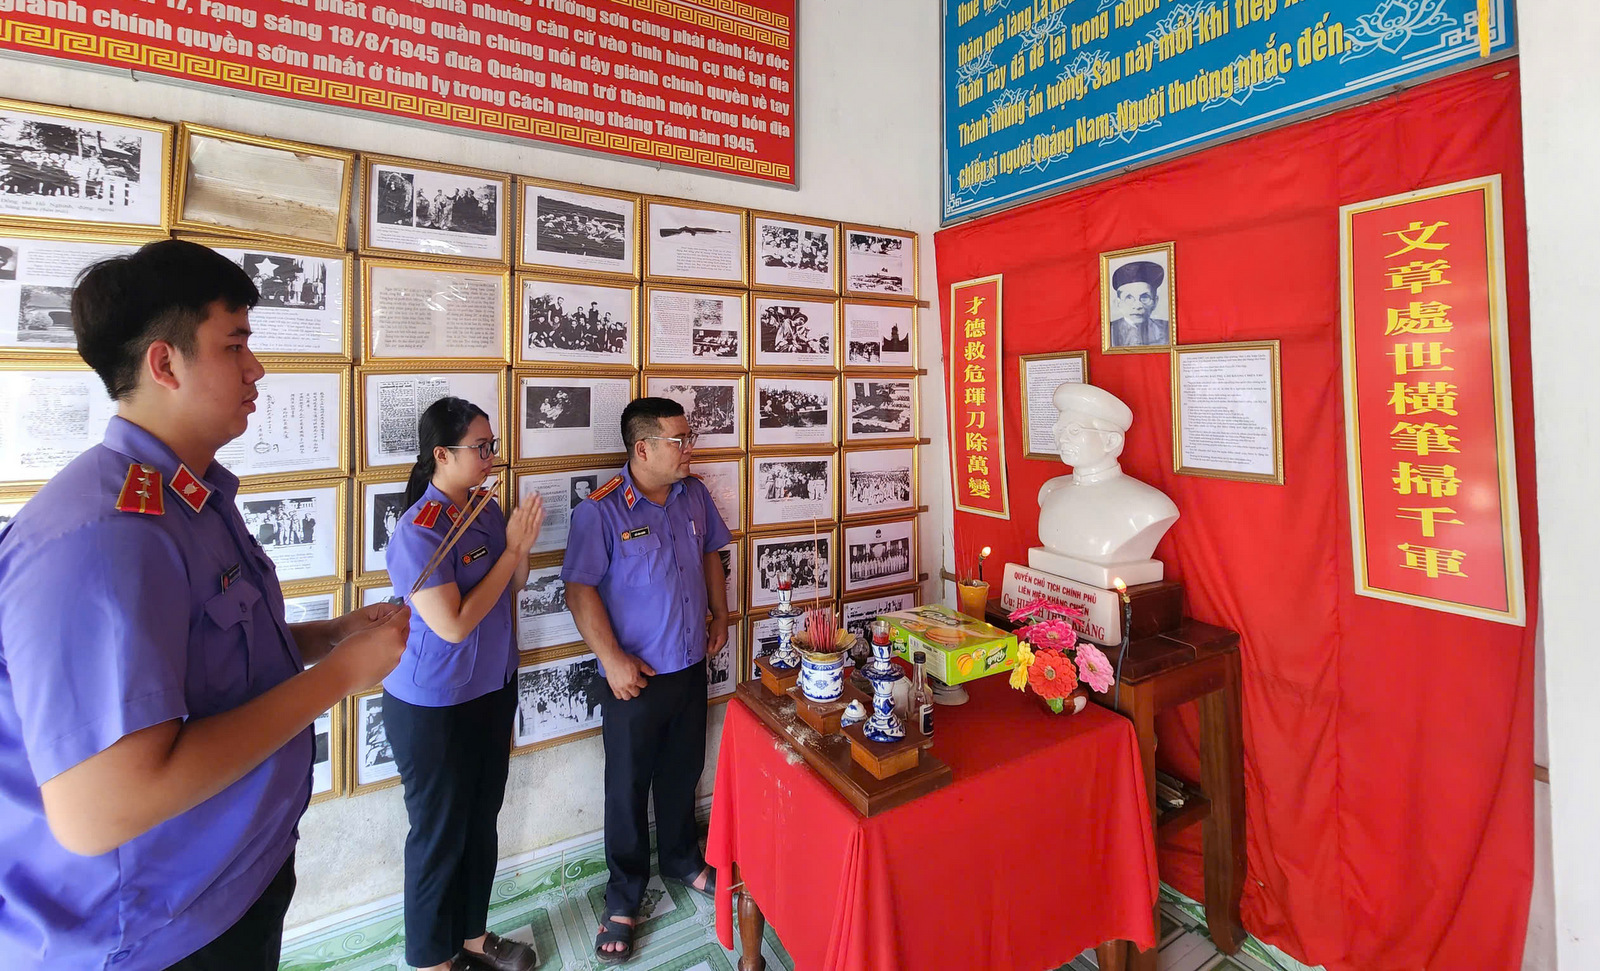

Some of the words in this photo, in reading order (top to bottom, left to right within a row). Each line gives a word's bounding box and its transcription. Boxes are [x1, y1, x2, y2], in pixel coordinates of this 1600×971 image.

[200, 0, 257, 28] rạng
[264, 13, 322, 42] sáng
[328, 25, 440, 64] 18/8/1945
[445, 50, 482, 73] đưa
[487, 59, 546, 88] Quảng
[550, 71, 589, 96] Nam
[592, 83, 617, 102] trở
[620, 88, 666, 112] thành
[669, 100, 698, 119] một
[701, 106, 739, 128] trong
[741, 114, 767, 133] bốn
[769, 119, 790, 138] địa
[371, 5, 426, 35] động
[430, 22, 481, 46] quần
[486, 32, 544, 61] chúng
[548, 47, 576, 68] nổi
[580, 55, 610, 76] dậy
[613, 62, 659, 86] giành
[662, 74, 704, 96] chính
[707, 84, 749, 107] quyền
[752, 93, 768, 110] về
[770, 99, 790, 117] tay
[472, 3, 532, 32] nhưng
[536, 19, 569, 40] căn
[573, 28, 596, 46] cứ
[598, 34, 628, 53] vào
[631, 42, 662, 63] tình
[666, 49, 699, 72] hình
[702, 61, 720, 78] cụ
[723, 64, 746, 83] thể
[748, 71, 767, 89] tại
[769, 76, 790, 94] địa
[599, 9, 630, 29] sơn
[631, 18, 671, 41] cũng
[672, 29, 705, 49] phải
[707, 36, 742, 59] dành
[744, 46, 764, 66] lấy
[765, 52, 790, 71] độc
[958, 113, 989, 148] Thành
[991, 100, 1026, 134] những
[1028, 84, 1044, 118] ấn
[1046, 73, 1088, 110] tượng.
[1092, 56, 1121, 90] Sau
[1125, 40, 1154, 77] này
[1159, 15, 1194, 62] mỗi
[1198, 1, 1229, 45] khi
[984, 18, 1005, 53] quê
[1006, 6, 1032, 39] làng
[987, 64, 1007, 93] này
[1010, 50, 1026, 81] đã
[1049, 28, 1067, 65] lại
[1071, 10, 1109, 50] trong
[92, 8, 172, 41] chính
[176, 26, 253, 57] quyền
[257, 43, 309, 68] sớm
[313, 54, 366, 79] nhất
[368, 62, 383, 81] ở
[386, 66, 428, 91] tỉnh
[453, 80, 505, 107] trong
[509, 90, 554, 115] Cách
[557, 103, 605, 127] mạng
[607, 111, 653, 135] tháng
[655, 120, 687, 140] Tám
[689, 129, 721, 146] năm
[722, 133, 758, 154] 1945.
[958, 152, 987, 189] chiến
[1000, 138, 1032, 175] người
[1033, 125, 1075, 163] Quảng
[1116, 85, 1166, 133] Người
[1168, 65, 1234, 114] thường
[1238, 32, 1293, 90] nhắc
[1297, 12, 1352, 67] đến.
[1018, 585, 1031, 596] LIÊN
[1033, 577, 1046, 588] CHỦ
[1047, 581, 1061, 593] TỊCH
[1061, 586, 1082, 599] CHÍNH
[1083, 592, 1097, 604] PHỦ
